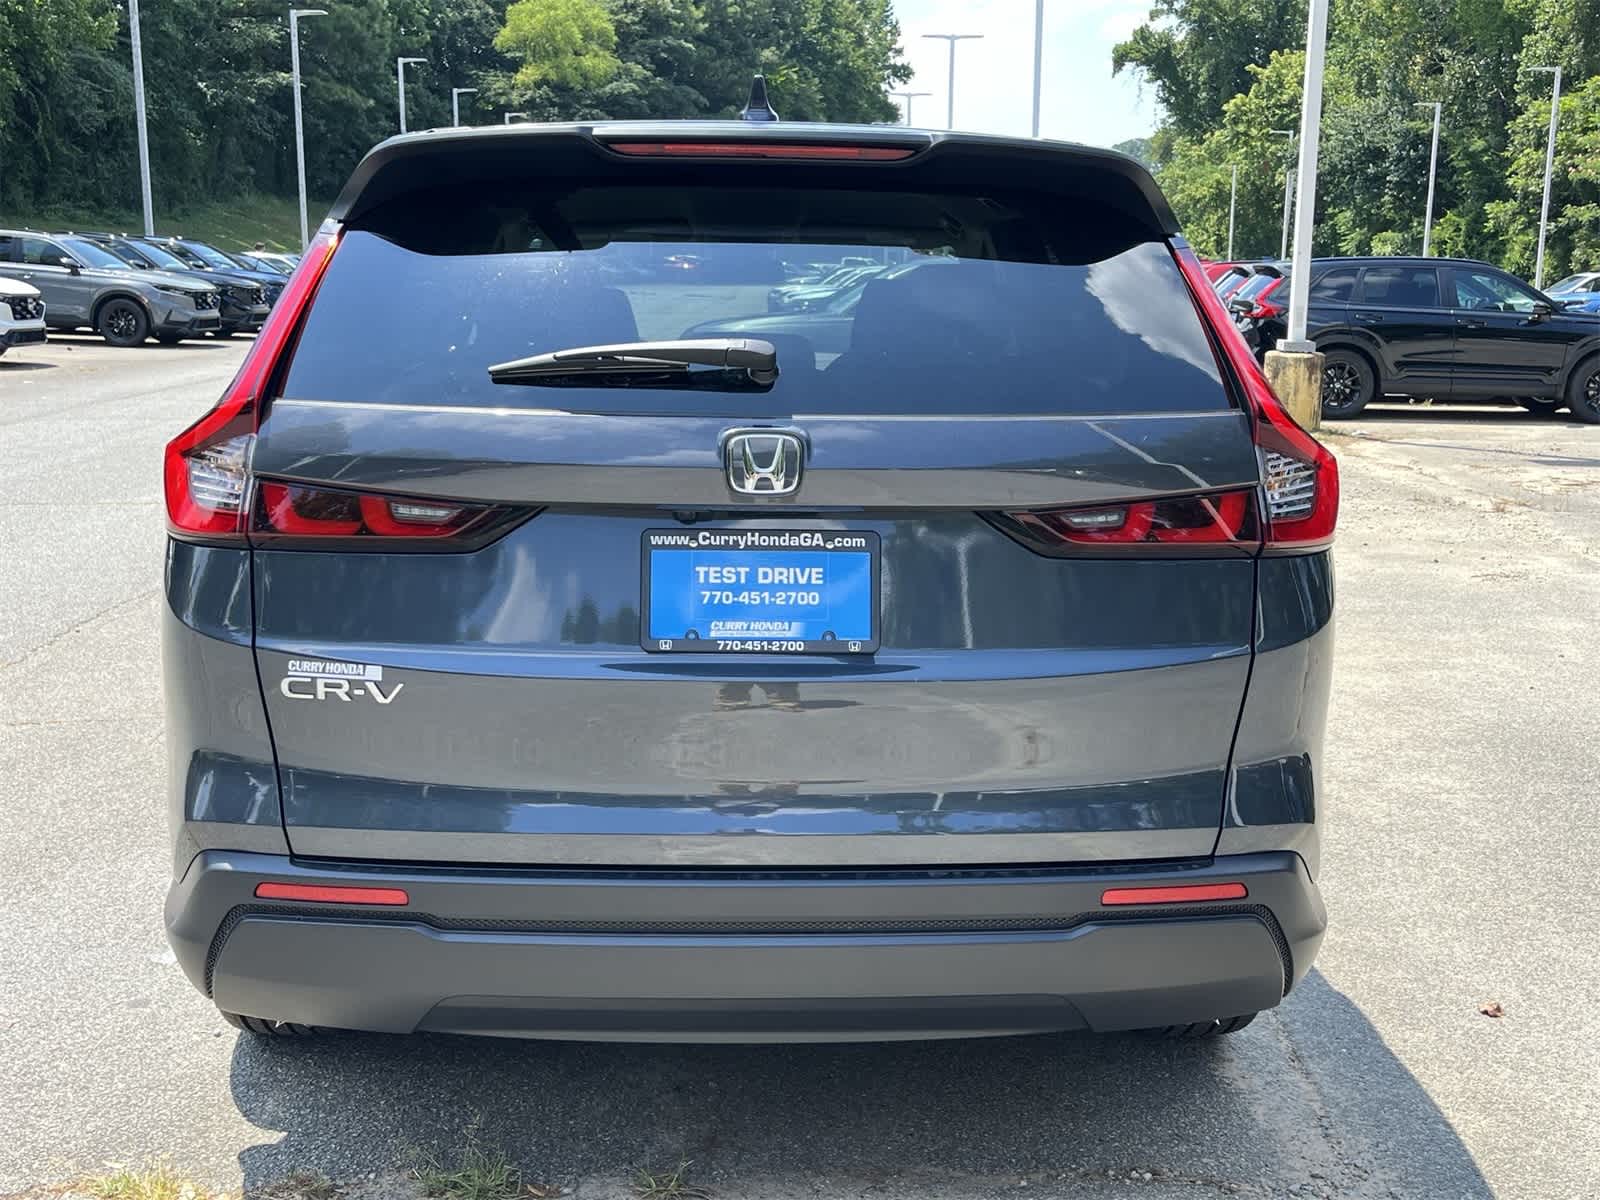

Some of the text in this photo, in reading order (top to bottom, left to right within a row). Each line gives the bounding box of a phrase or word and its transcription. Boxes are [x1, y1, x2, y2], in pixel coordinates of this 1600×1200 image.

[696, 567, 823, 585] TEST DRIVE
[701, 591, 820, 605] 770-451-2700
[711, 621, 789, 632] CURRY HONDA
[717, 640, 804, 651] 770-451-2700
[288, 660, 364, 675] CURRY HONDA
[280, 676, 404, 704] CR-V
